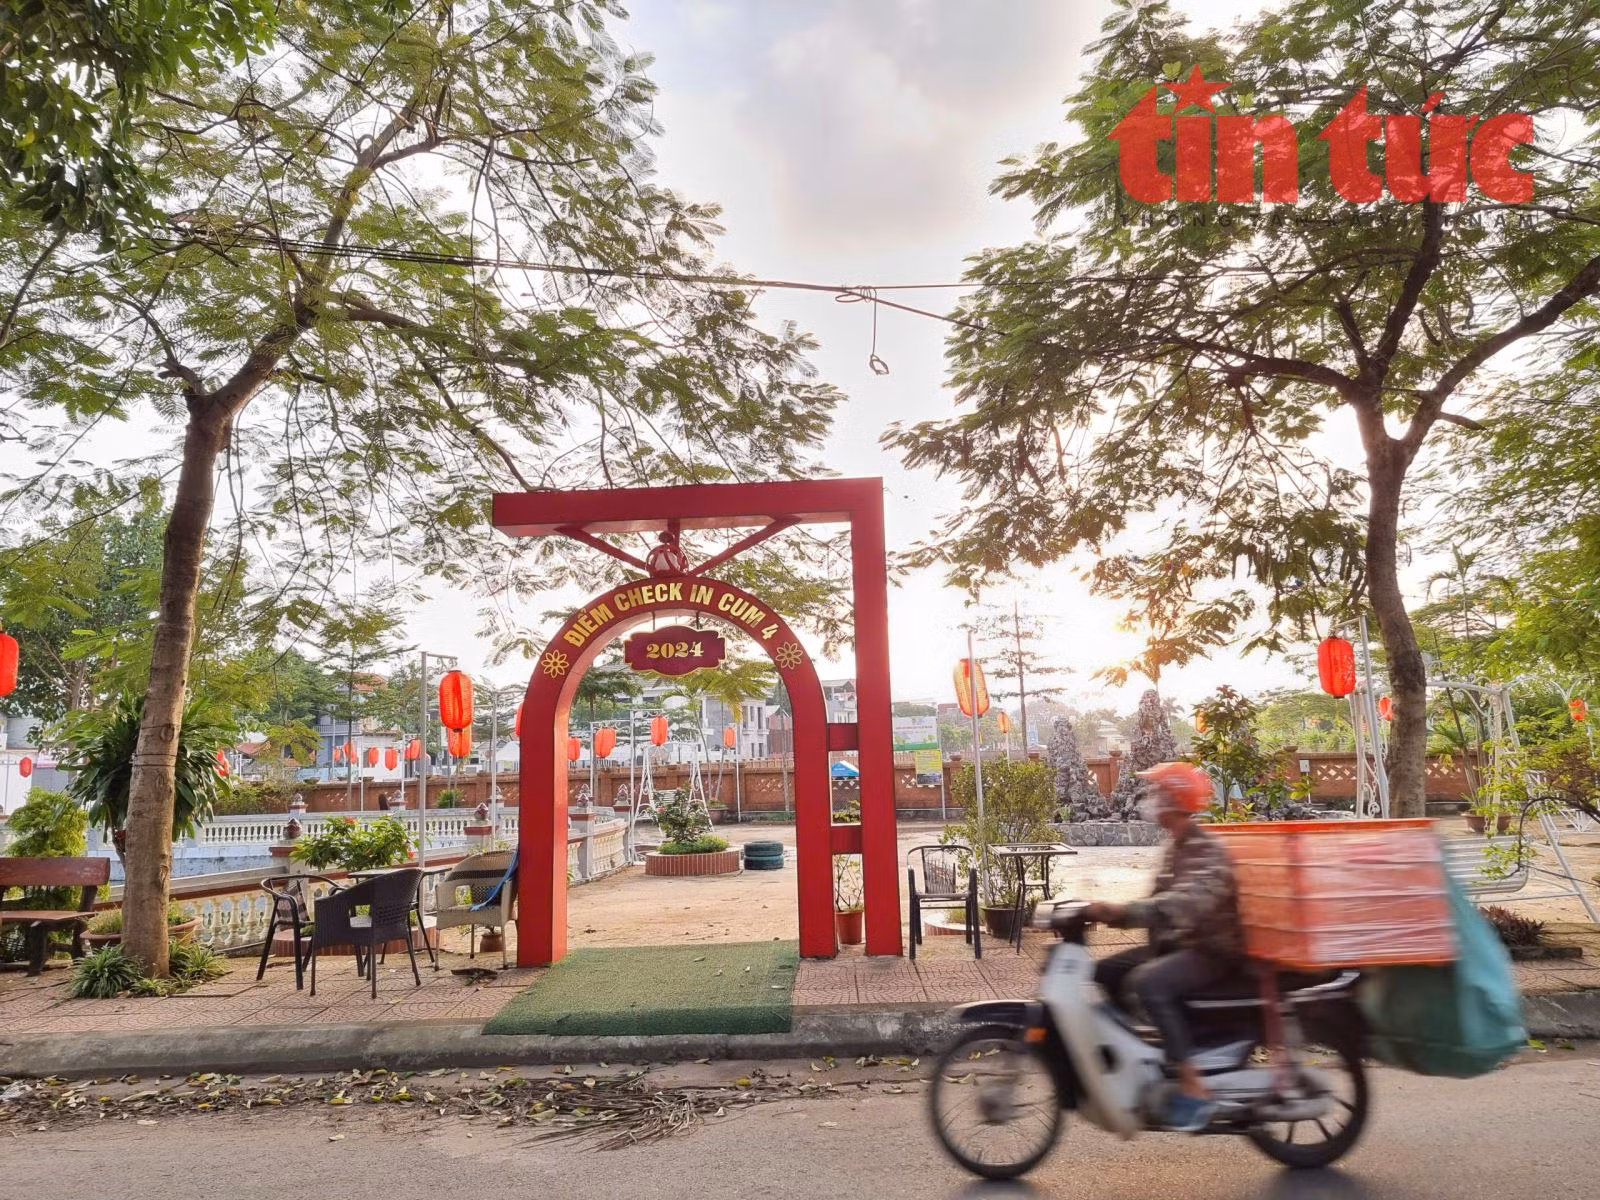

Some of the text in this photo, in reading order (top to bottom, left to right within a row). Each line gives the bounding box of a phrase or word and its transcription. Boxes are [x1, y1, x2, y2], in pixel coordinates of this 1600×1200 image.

[563, 603, 614, 647] ĐIỂM
[614, 582, 682, 611] CHECK
[690, 584, 714, 606] IN
[761, 623, 780, 640] 4
[646, 641, 705, 660] 2024
